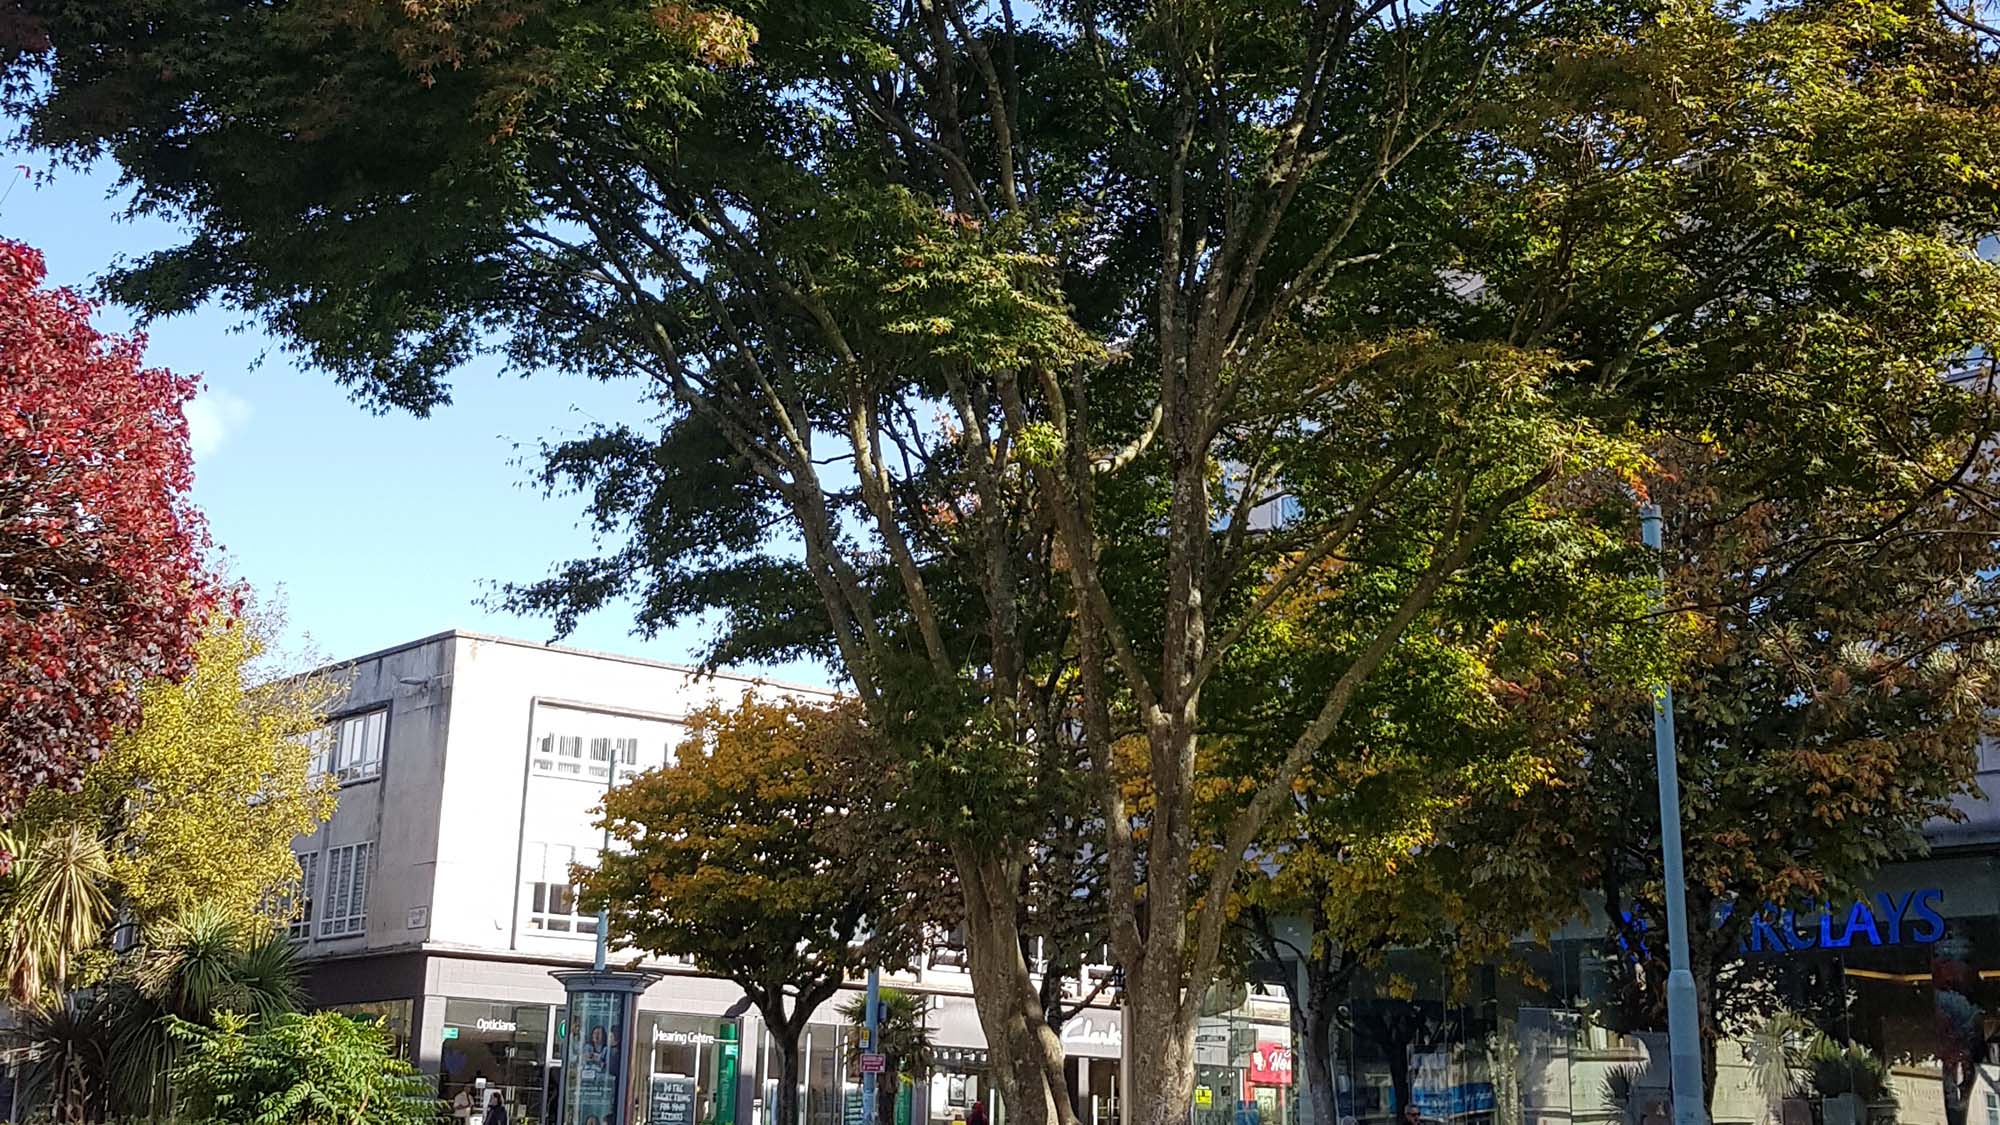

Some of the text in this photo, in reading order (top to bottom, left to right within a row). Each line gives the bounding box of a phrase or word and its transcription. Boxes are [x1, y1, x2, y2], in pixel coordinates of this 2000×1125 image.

[1705, 888, 1946, 953] RCLAYS
[476, 1017, 516, 1032] Opticians
[1061, 1016, 1121, 1046] Clark
[655, 1029, 715, 1045] Hearing Centre
